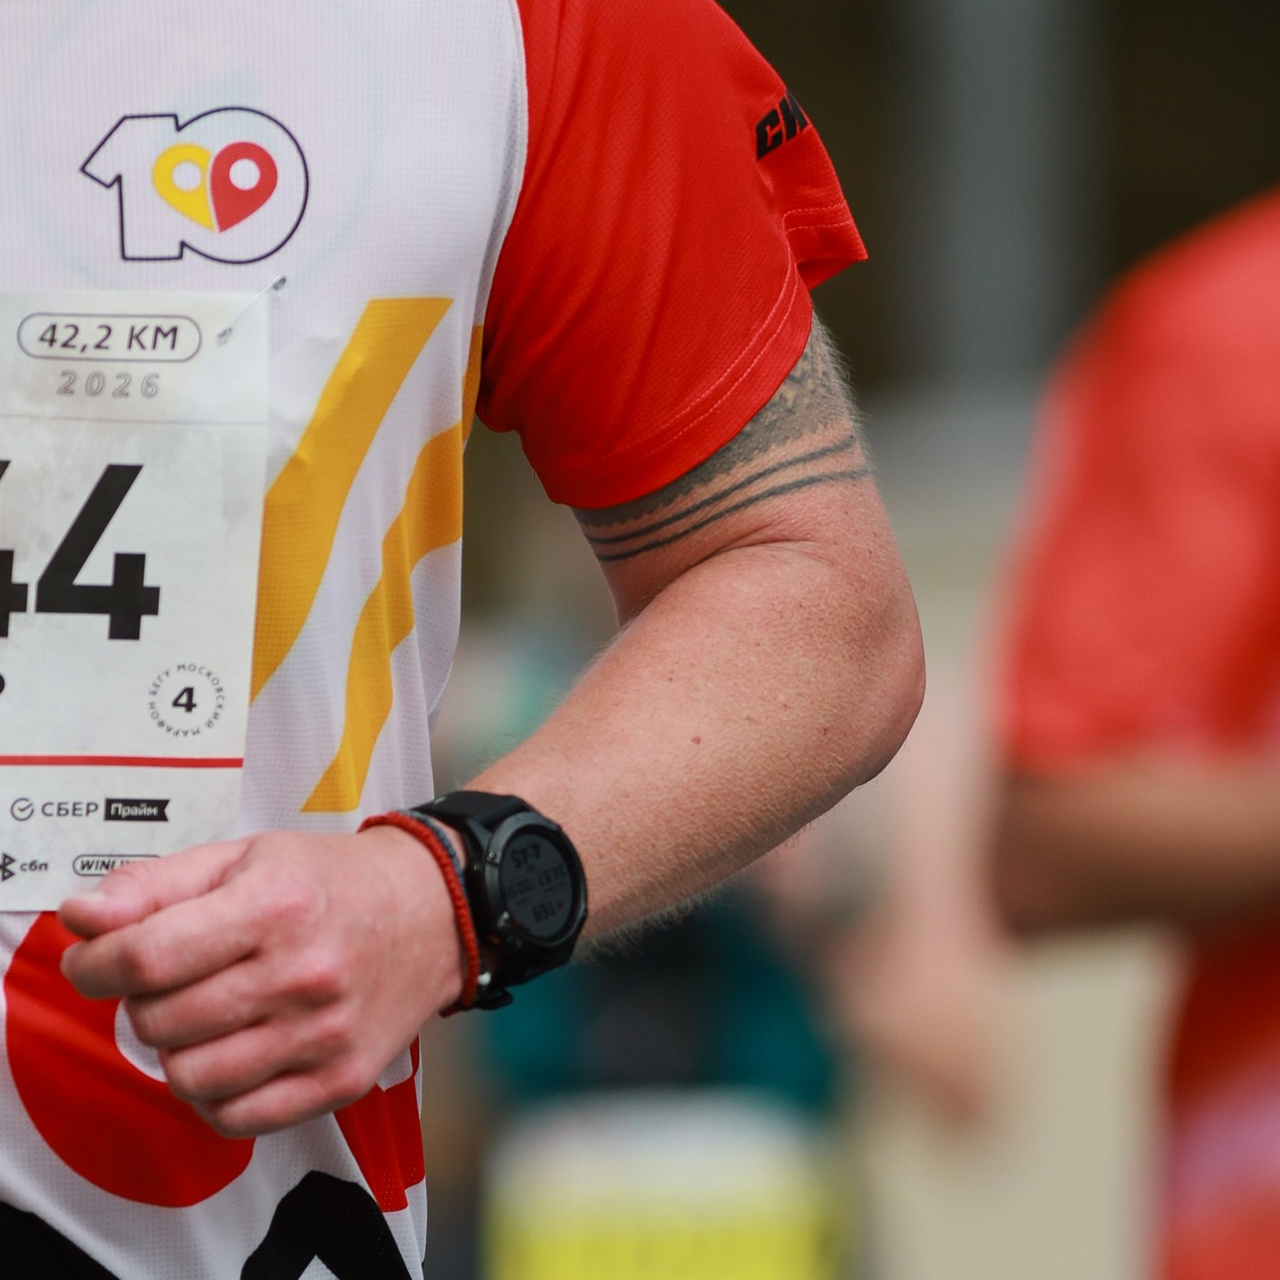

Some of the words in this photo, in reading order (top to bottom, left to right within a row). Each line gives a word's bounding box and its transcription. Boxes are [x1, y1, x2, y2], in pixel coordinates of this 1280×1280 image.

[38, 322, 113, 354] 42,2
[126, 323, 180, 352] КМ
[55, 370, 161, 399] 2026
[171, 686, 197, 713] 4
[41, 801, 99, 818] СБЕР
[110, 802, 159, 819] Прайм
[19, 859, 50, 872] сбп
